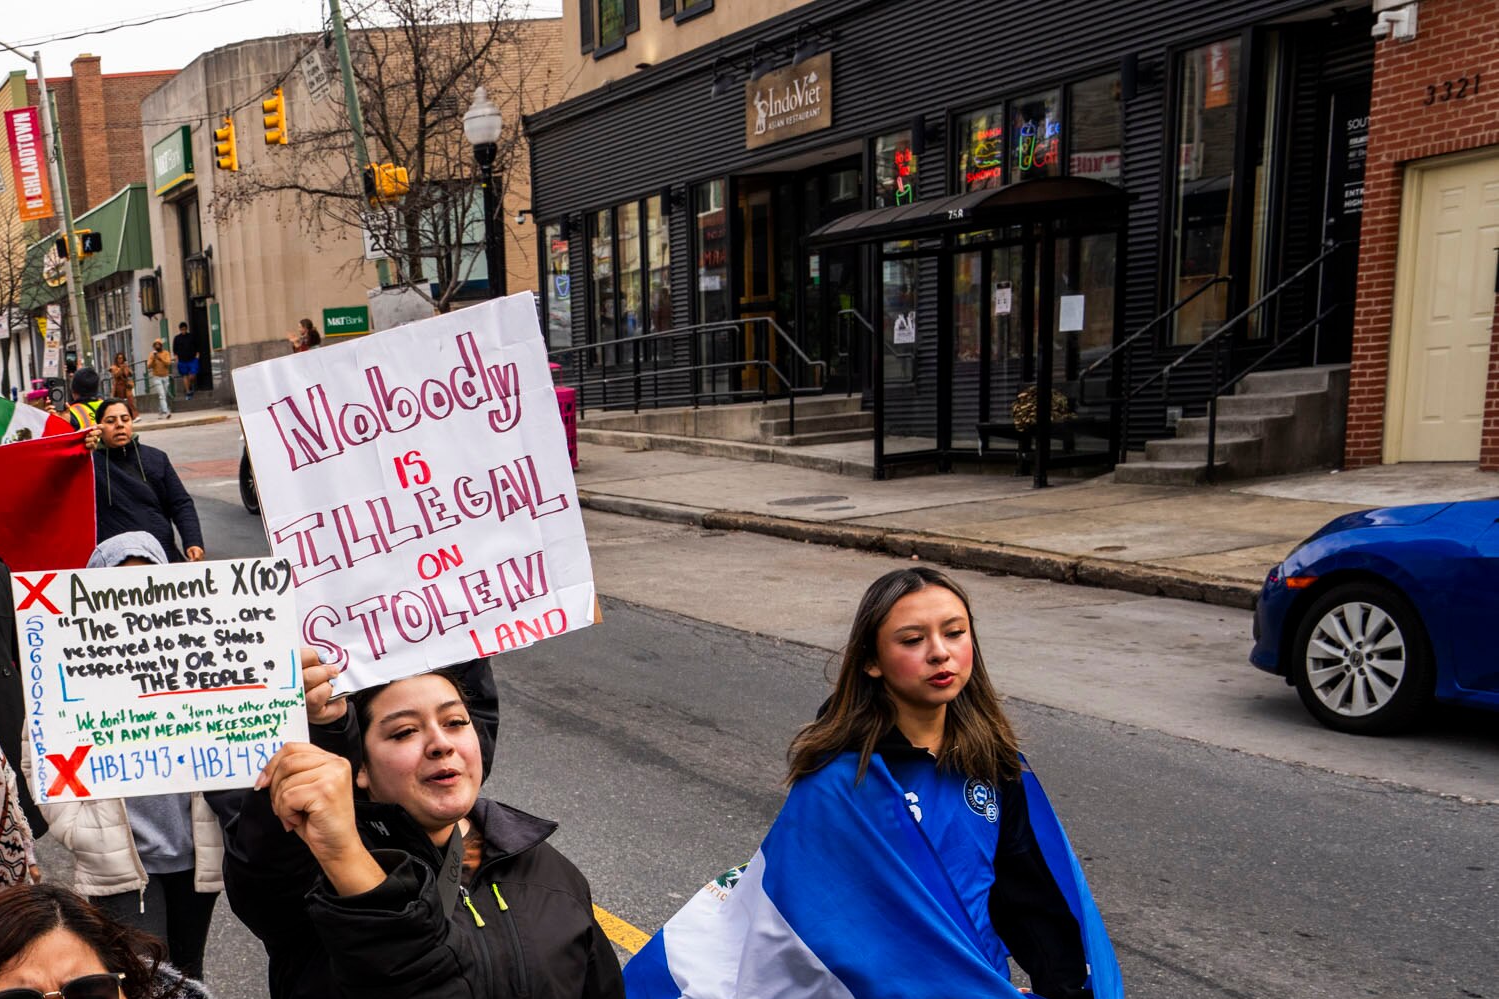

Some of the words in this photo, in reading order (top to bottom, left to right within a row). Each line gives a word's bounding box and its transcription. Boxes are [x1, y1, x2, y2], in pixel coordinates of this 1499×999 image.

[768, 75, 821, 117] IndoViet
[1423, 73, 1481, 106] 3321
[768, 120, 785, 130] ASIAN
[785, 107, 821, 125] RESTAURANT
[327, 316, 345, 327] M&T
[345, 314, 364, 325] Bank
[267, 331, 522, 471] Nobody
[393, 450, 432, 489] IS
[273, 455, 569, 589] ILLEGAL
[417, 544, 464, 580] ON
[70, 567, 219, 616] Amendment
[303, 551, 549, 672] STOLEN
[63, 638, 150, 660] reserved
[154, 635, 175, 651] to
[177, 632, 207, 649] the
[214, 628, 265, 647] States
[469, 608, 568, 658] LAND
[66, 655, 179, 678] respectively
[185, 651, 216, 671] OR
[223, 648, 248, 663] to
[131, 672, 180, 695] THE
[102, 707, 126, 729] don't
[130, 709, 158, 723] have
[166, 711, 175, 720] a
[216, 701, 234, 714] the
[238, 699, 264, 713] other
[121, 725, 150, 742] ANY
[155, 721, 202, 738] MEANS
[206, 710, 288, 734] NECESSARY!
[269, 727, 279, 738] X
[89, 746, 173, 785] HB1343
